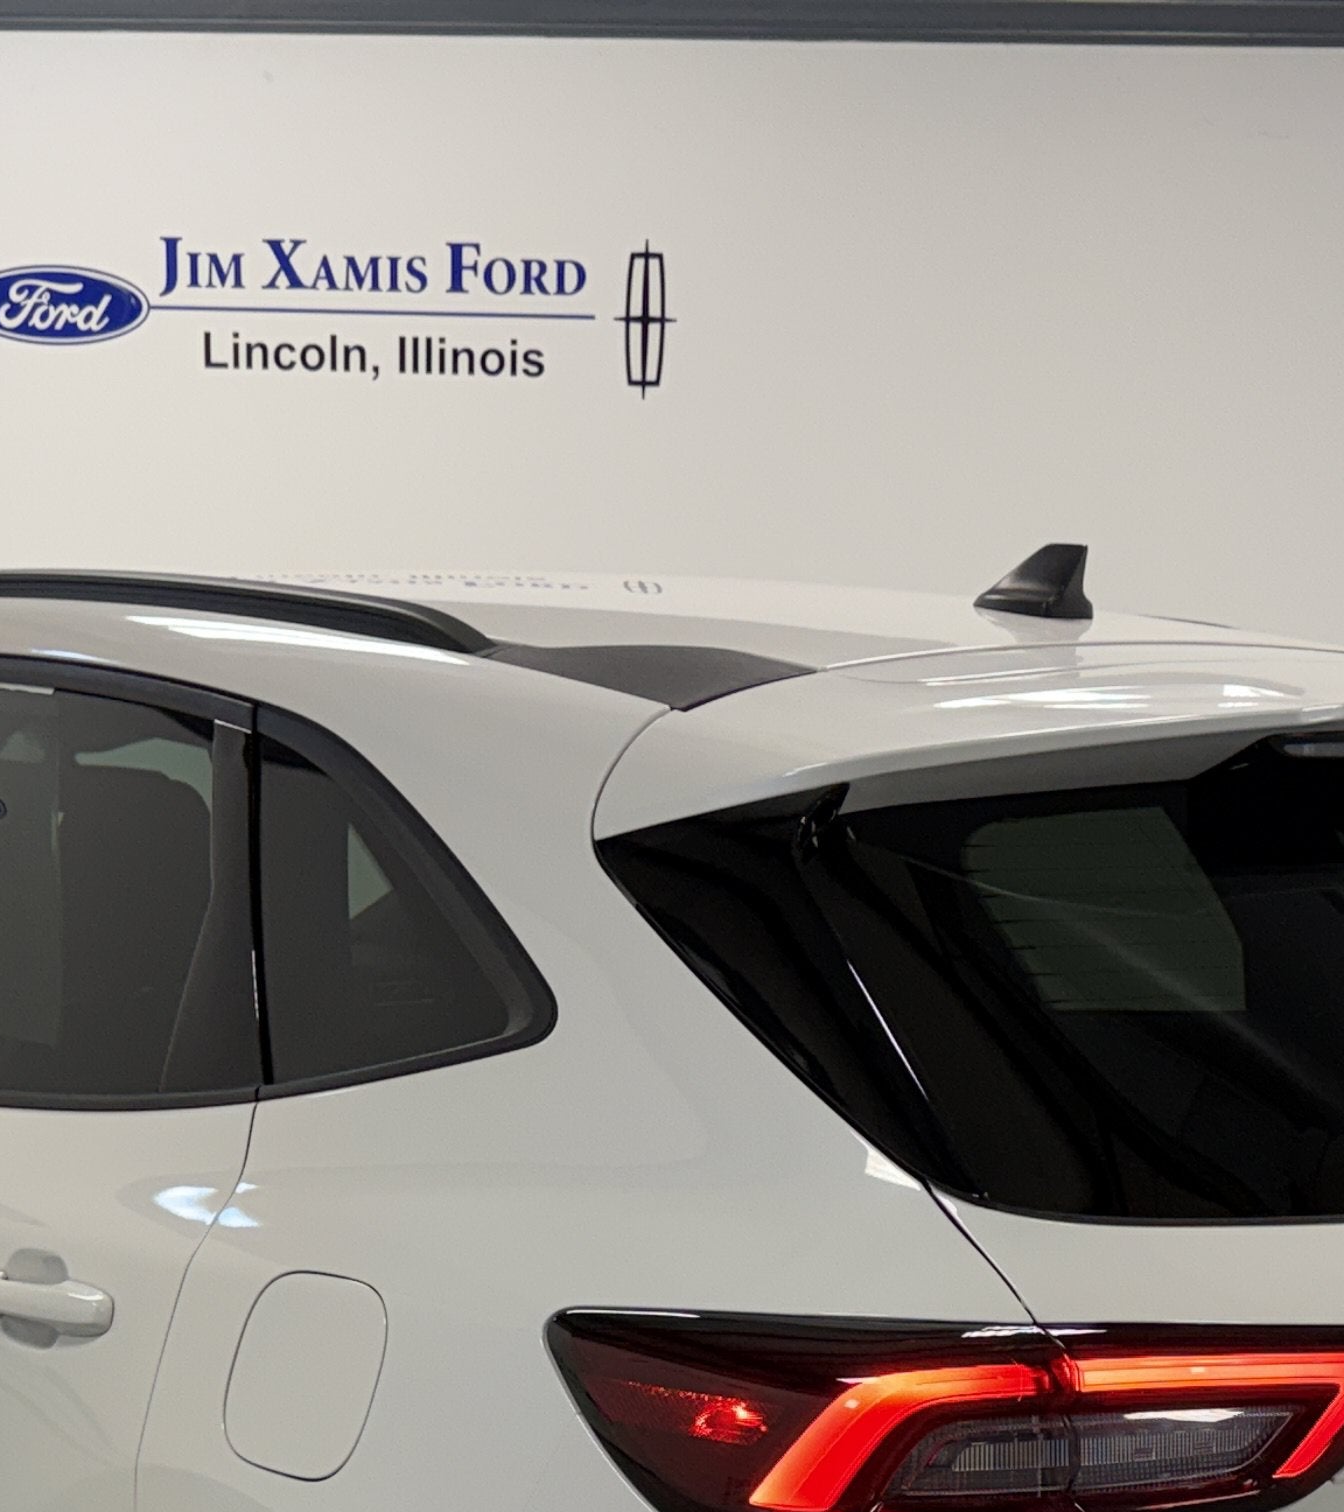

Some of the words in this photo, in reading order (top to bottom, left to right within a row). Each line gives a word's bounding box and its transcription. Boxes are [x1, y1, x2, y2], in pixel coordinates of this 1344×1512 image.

[159, 236, 244, 297] JIM
[262, 239, 428, 293] XAMIS
[446, 242, 587, 296] FORD
[204, 331, 380, 380] Lincoln,
[399, 336, 545, 377] Illinois
